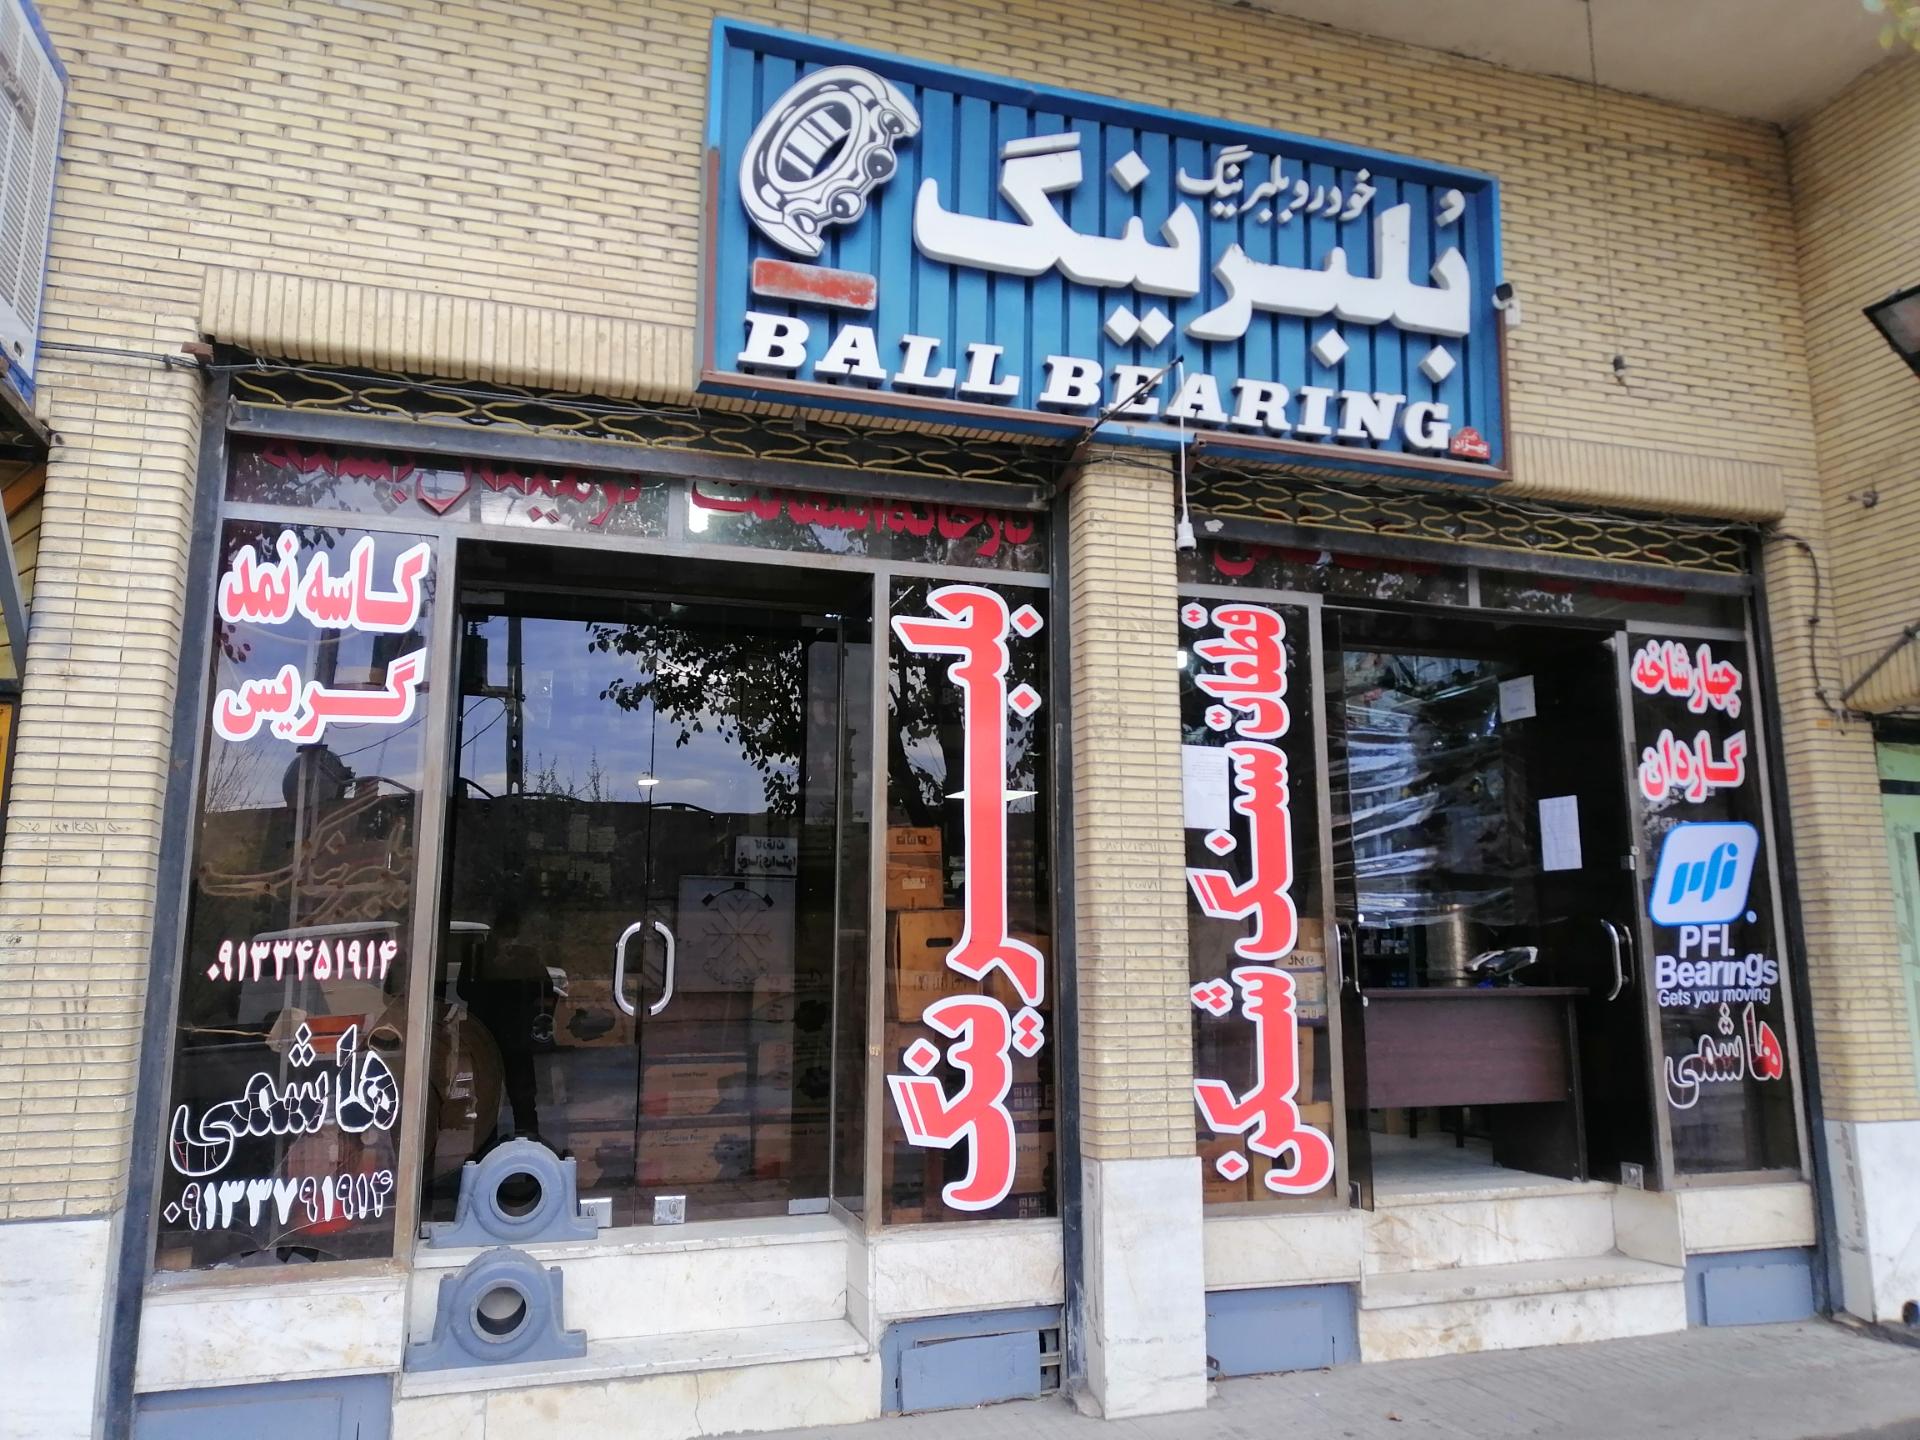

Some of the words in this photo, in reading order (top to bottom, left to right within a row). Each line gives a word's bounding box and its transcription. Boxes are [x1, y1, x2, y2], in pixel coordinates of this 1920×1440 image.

[1176, 144, 1294, 223] بلبرینگ
[1291, 167, 1377, 221] خودرو
[738, 311, 1021, 400] BALL
[1038, 354, 1451, 453] BEARING
[218, 529, 299, 625] نمد
[298, 535, 431, 633] کاسه
[213, 647, 427, 744] گریس
[1181, 602, 1290, 740] قطعات
[886, 584, 1046, 1212] بلبرینگ
[1185, 740, 1298, 961] سنگ
[207, 939, 398, 982] ۰۹۱۳۳۴۵۱۹۱۴
[1655, 953, 1779, 989] Bearings
[1657, 988, 1691, 1008] Gets
[1693, 988, 1720, 1009] you
[1722, 986, 1771, 1005] moving
[1190, 965, 1335, 1195] شکن
